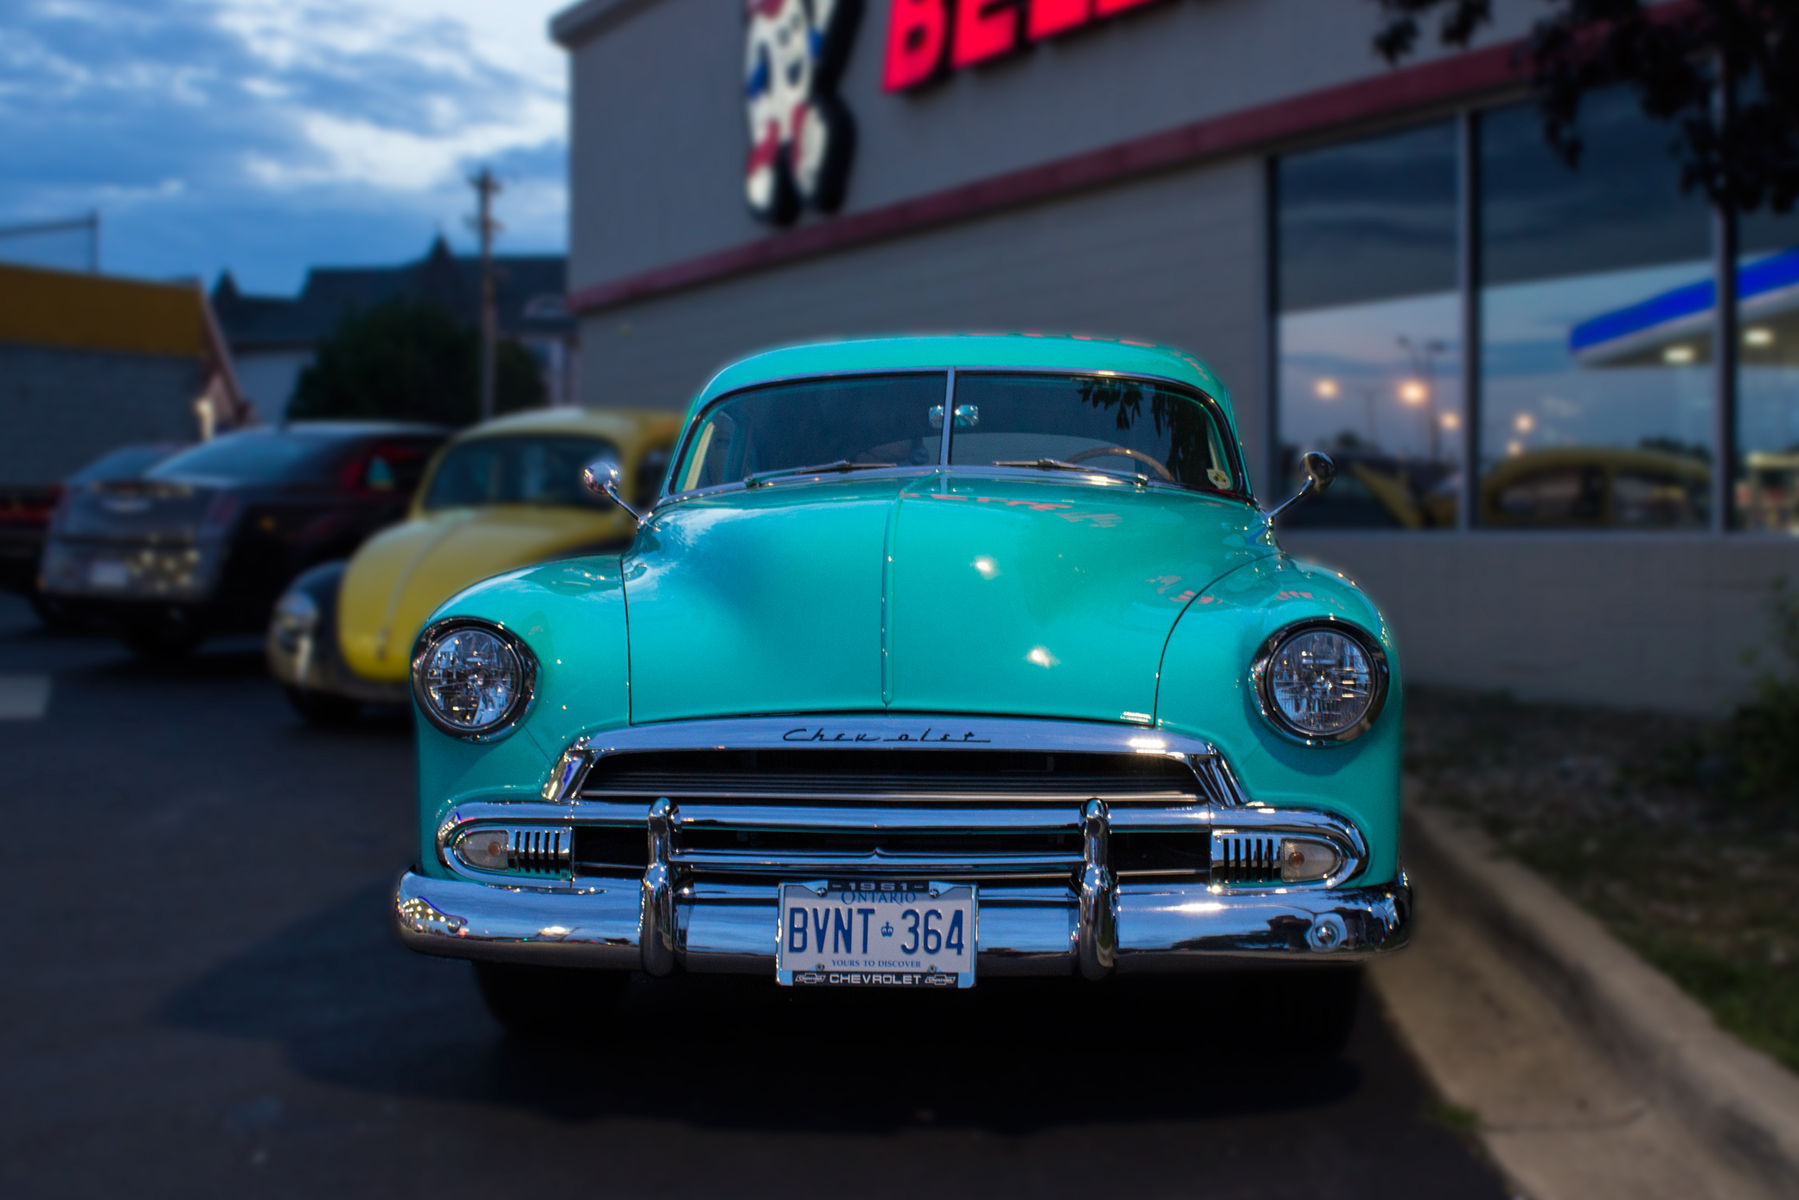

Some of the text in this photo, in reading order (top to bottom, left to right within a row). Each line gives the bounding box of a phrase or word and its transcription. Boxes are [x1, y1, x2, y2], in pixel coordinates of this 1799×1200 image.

[882, 0, 1152, 94] BE
[783, 728, 991, 743] Chevolet
[841, 891, 916, 905] ONTARIO
[788, 907, 964, 955] BVNT 364
[832, 959, 921, 969] YOURS TO DISCOVER
[829, 974, 922, 985] CHEVROLET
